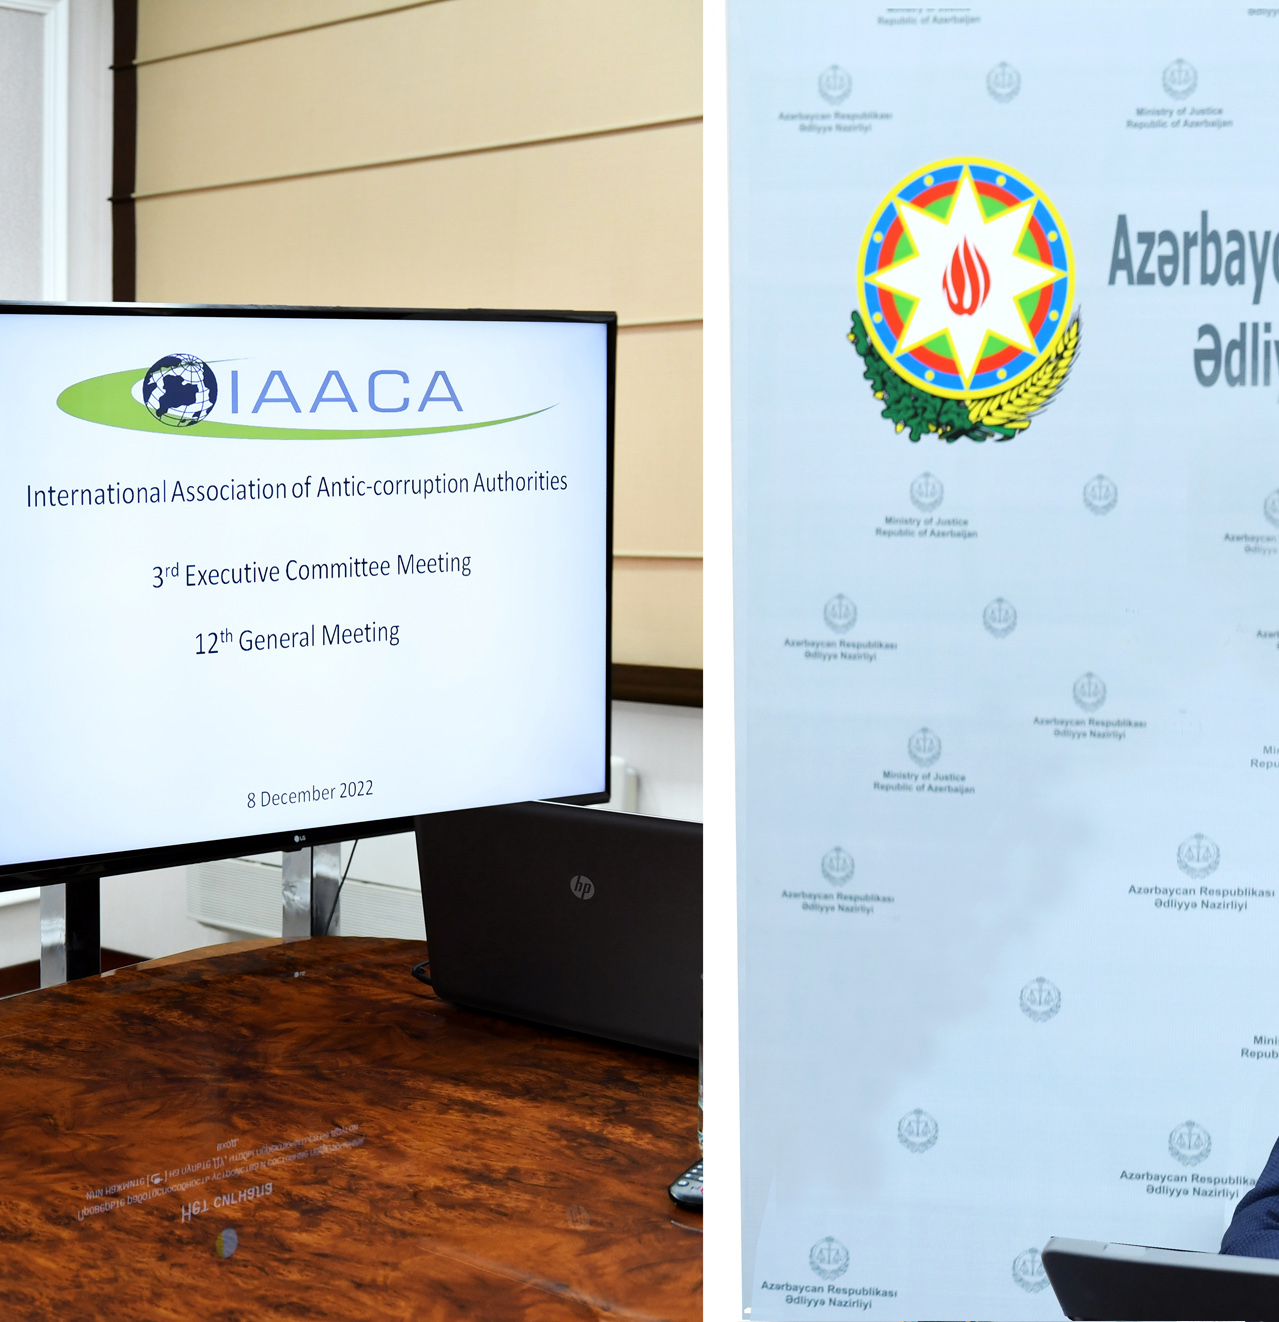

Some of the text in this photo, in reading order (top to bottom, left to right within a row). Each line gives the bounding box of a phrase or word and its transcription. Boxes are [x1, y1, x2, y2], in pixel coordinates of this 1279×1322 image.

[230, 369, 463, 415] IAACA
[26, 471, 568, 507] International Association of Antic-corruption Authorities
[152, 552, 472, 589] 3rd Executive Committee Meeting
[195, 621, 400, 655] 12th General Meeting
[247, 779, 373, 809] 8 December 2022
[573, 876, 592, 899] hp
[1200, 886, 1275, 898] Respublikası
[1201, 900, 1247, 911] Nazirliyi
